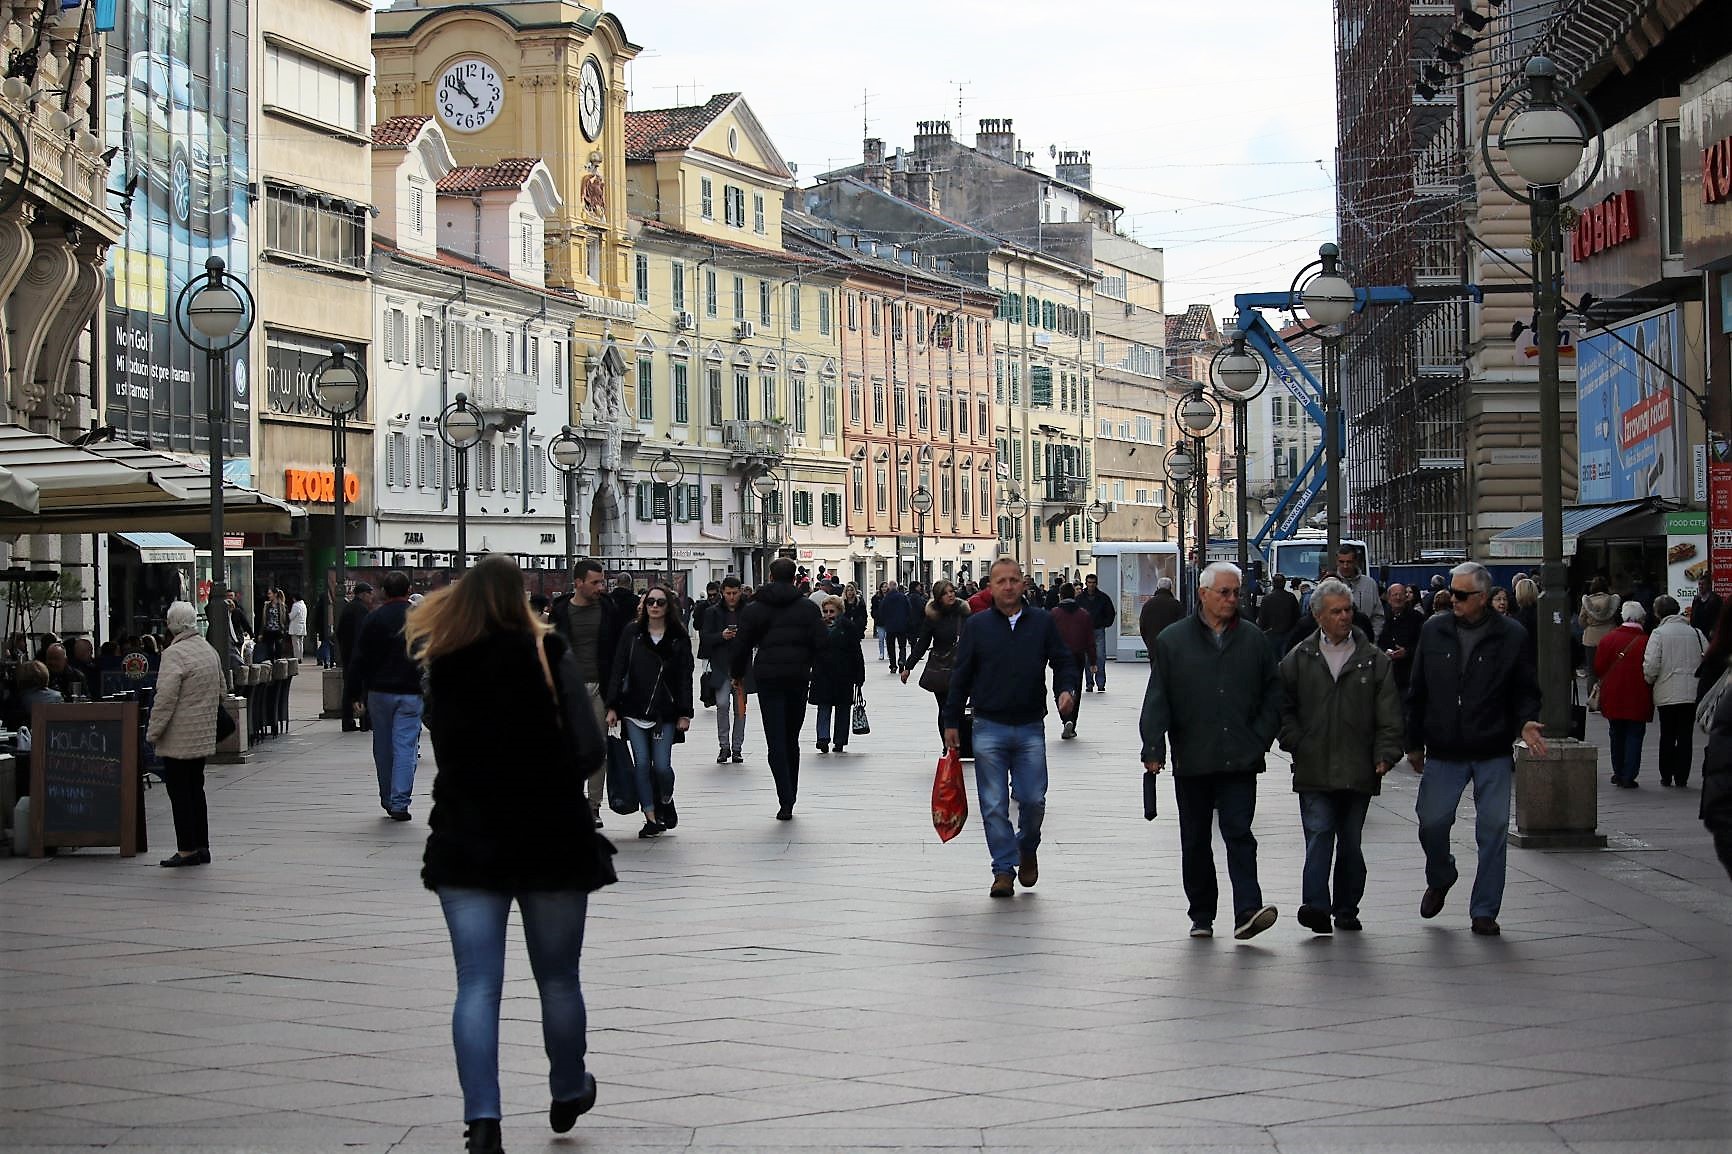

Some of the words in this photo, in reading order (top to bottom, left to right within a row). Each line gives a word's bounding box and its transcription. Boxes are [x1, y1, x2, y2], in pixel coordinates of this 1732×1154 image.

[466, 63, 477, 78] 12
[487, 73, 494, 87] 2
[440, 89, 448, 103] 9
[492, 86, 500, 101] 3
[445, 103, 453, 117] 8
[485, 101, 494, 114] 4
[455, 113, 464, 126] 7
[465, 114, 474, 128] 6
[477, 111, 485, 125] 5
[286, 469, 360, 503] KORO
[1669, 519, 1688, 527] FOOD
[404, 532, 425, 545] ZARA
